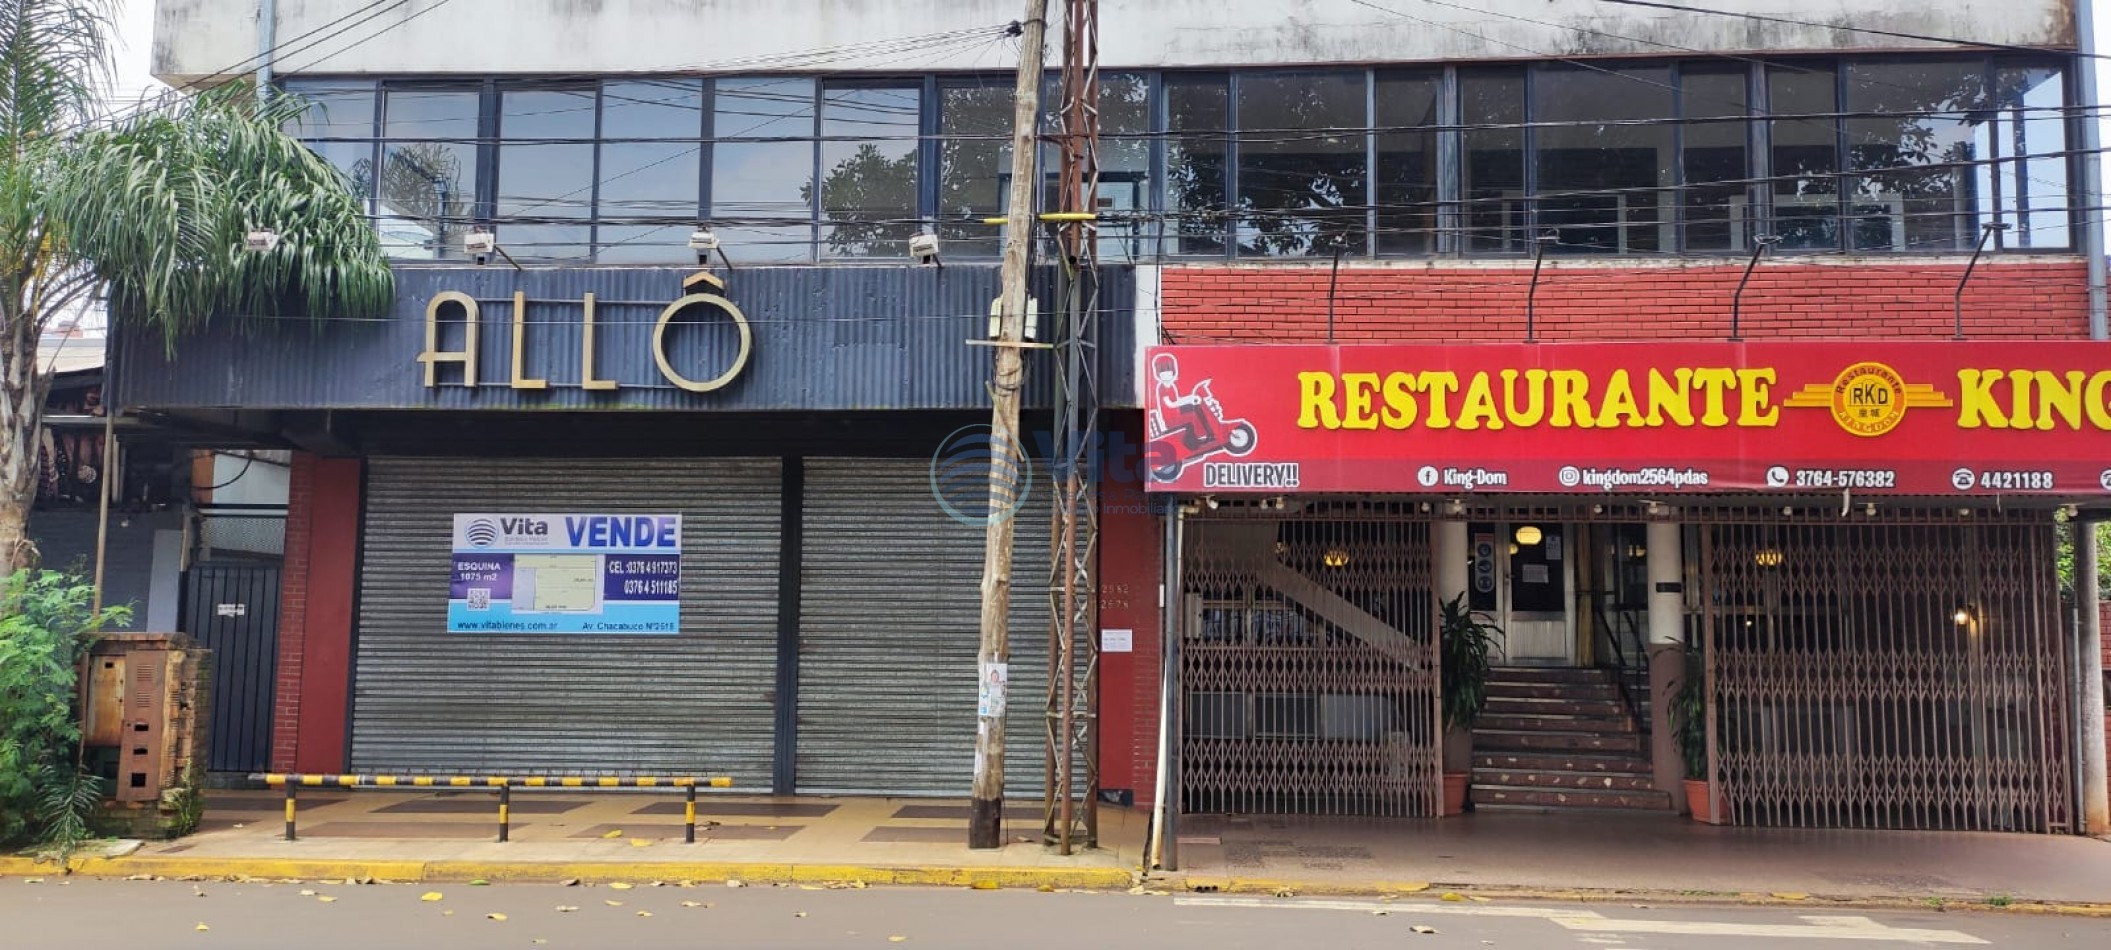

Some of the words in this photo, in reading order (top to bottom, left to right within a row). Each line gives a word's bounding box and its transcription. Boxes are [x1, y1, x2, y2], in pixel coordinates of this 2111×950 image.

[416, 271, 752, 393] ALLÔ
[1297, 368, 1780, 430] RESTAURANTE
[1853, 383, 1888, 405] RKD
[1204, 463, 1299, 487] DELIVERY!!
[1443, 467, 1507, 488] King-Dom
[1583, 467, 1708, 488] kingdom2564pdas
[1796, 470, 1895, 488] 3764-576382
[1981, 471, 2053, 488] 4421188
[500, 517, 548, 535] Vita
[565, 516, 677, 547] VENDE
[457, 561, 501, 571] ESQUINA
